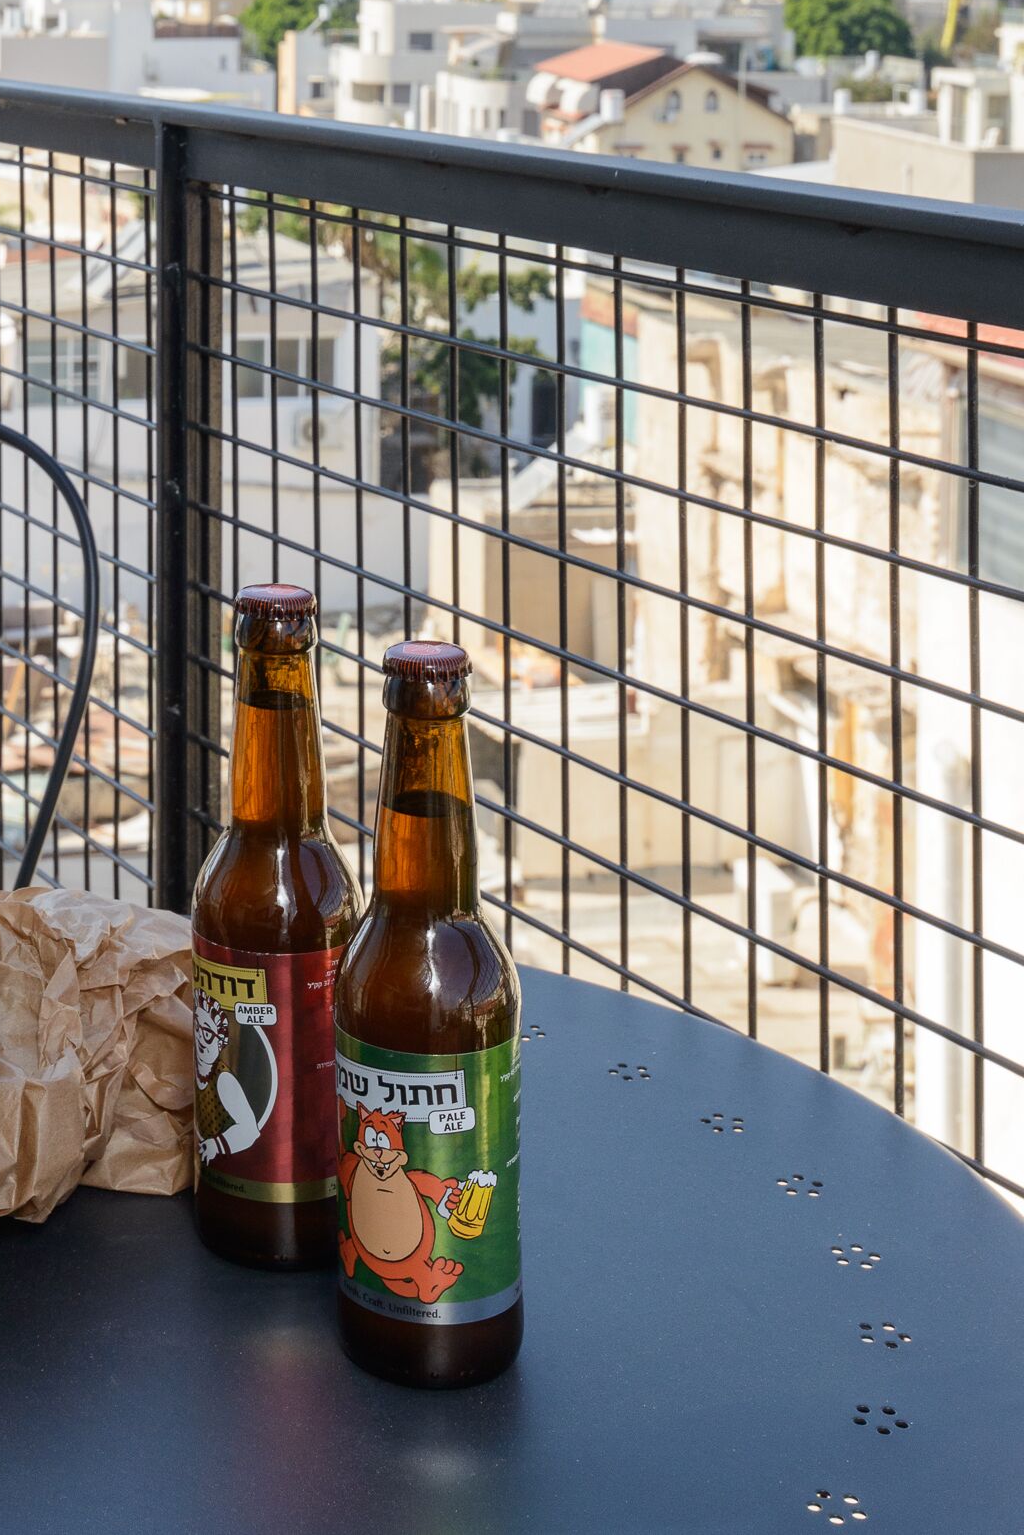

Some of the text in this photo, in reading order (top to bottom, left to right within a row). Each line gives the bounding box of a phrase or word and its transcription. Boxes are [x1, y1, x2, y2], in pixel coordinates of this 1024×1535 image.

[238, 1005, 273, 1015] AMBER
[247, 1015, 265, 1024] ALE
[377, 1075, 458, 1106] חתול
[439, 1111, 466, 1123] PALE
[443, 1121, 464, 1132] ALE
[389, 1303, 442, 1319] Unfiltered.
